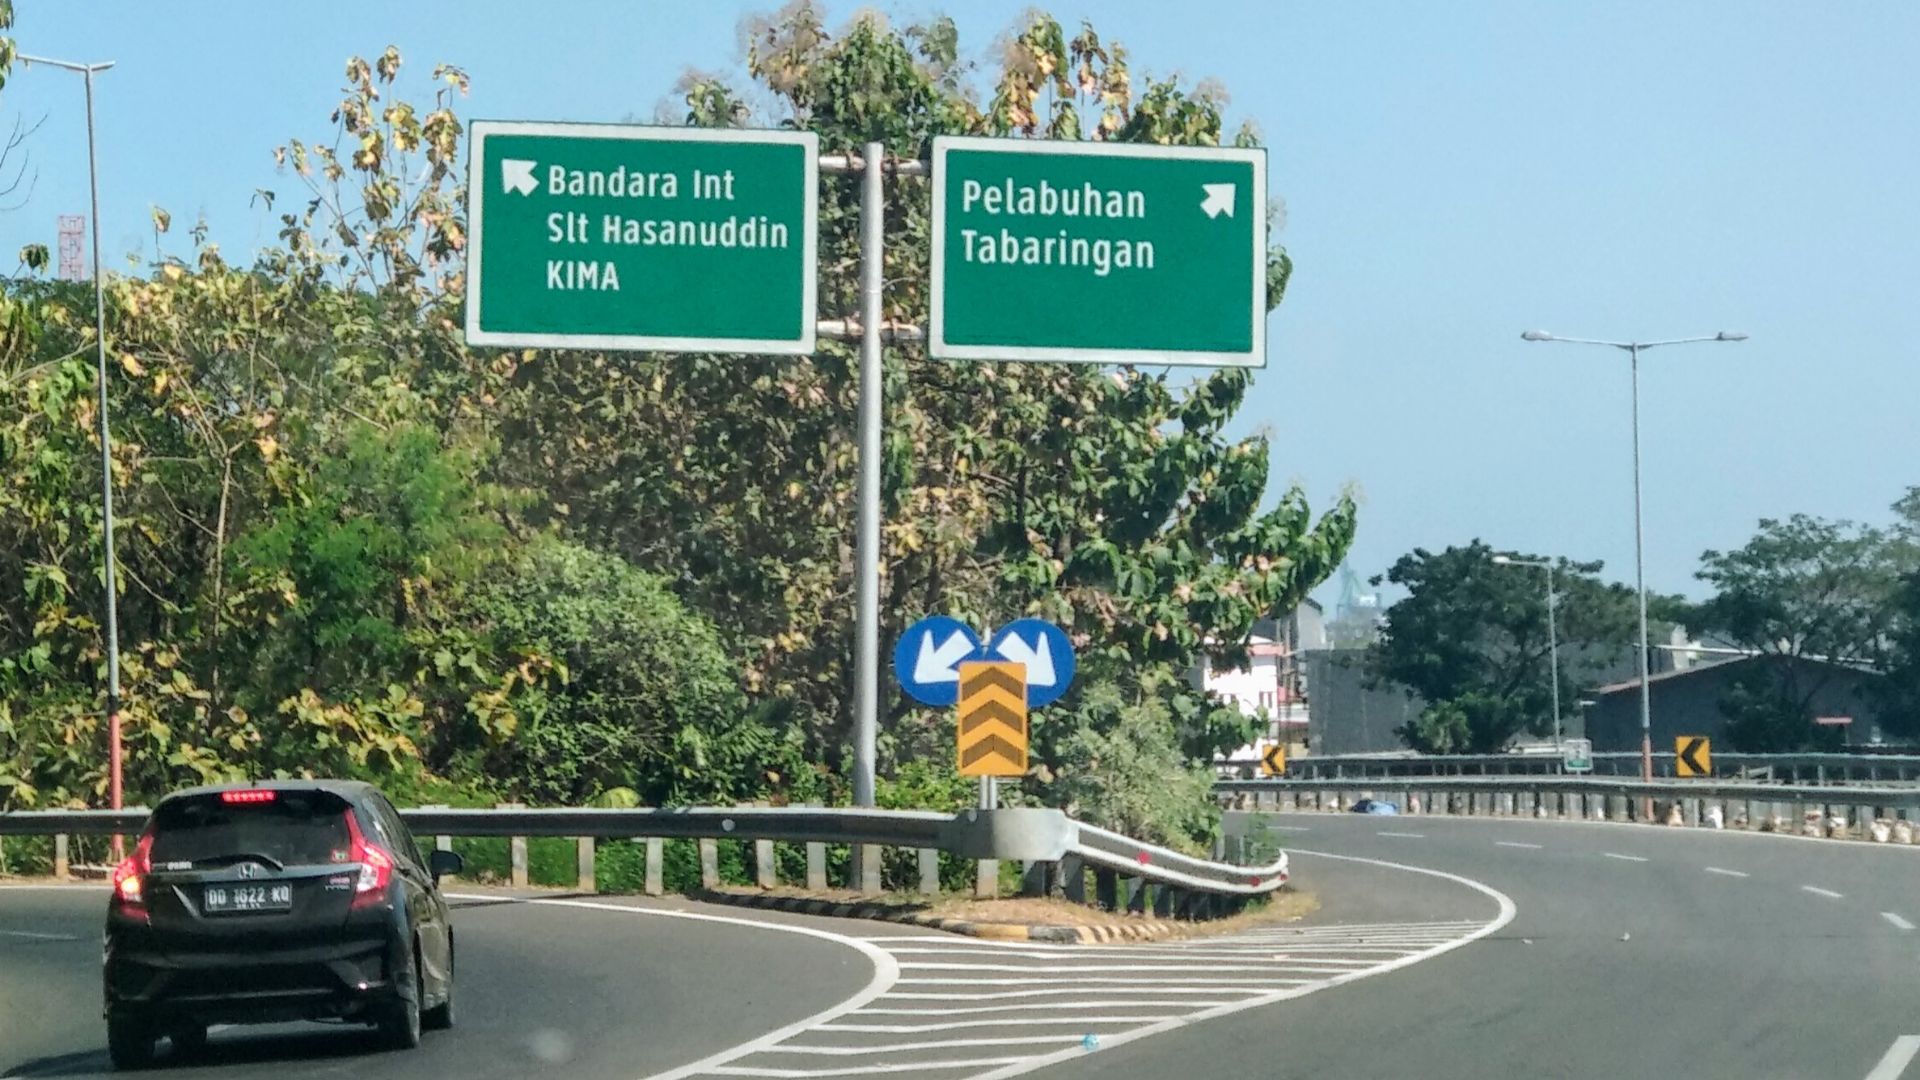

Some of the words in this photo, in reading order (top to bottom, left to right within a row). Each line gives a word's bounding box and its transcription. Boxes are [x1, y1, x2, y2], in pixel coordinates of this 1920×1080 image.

[548, 165, 678, 199] Bandara
[694, 169, 736, 200] Int
[963, 178, 1146, 218] Pelabuhan
[547, 212, 589, 244] Slt
[603, 214, 788, 248] Hasanuddin
[961, 229, 1155, 277] Tabaringan
[547, 260, 621, 291] KIMA
[208, 889, 226, 905] DD
[234, 887, 266, 904] 1622
